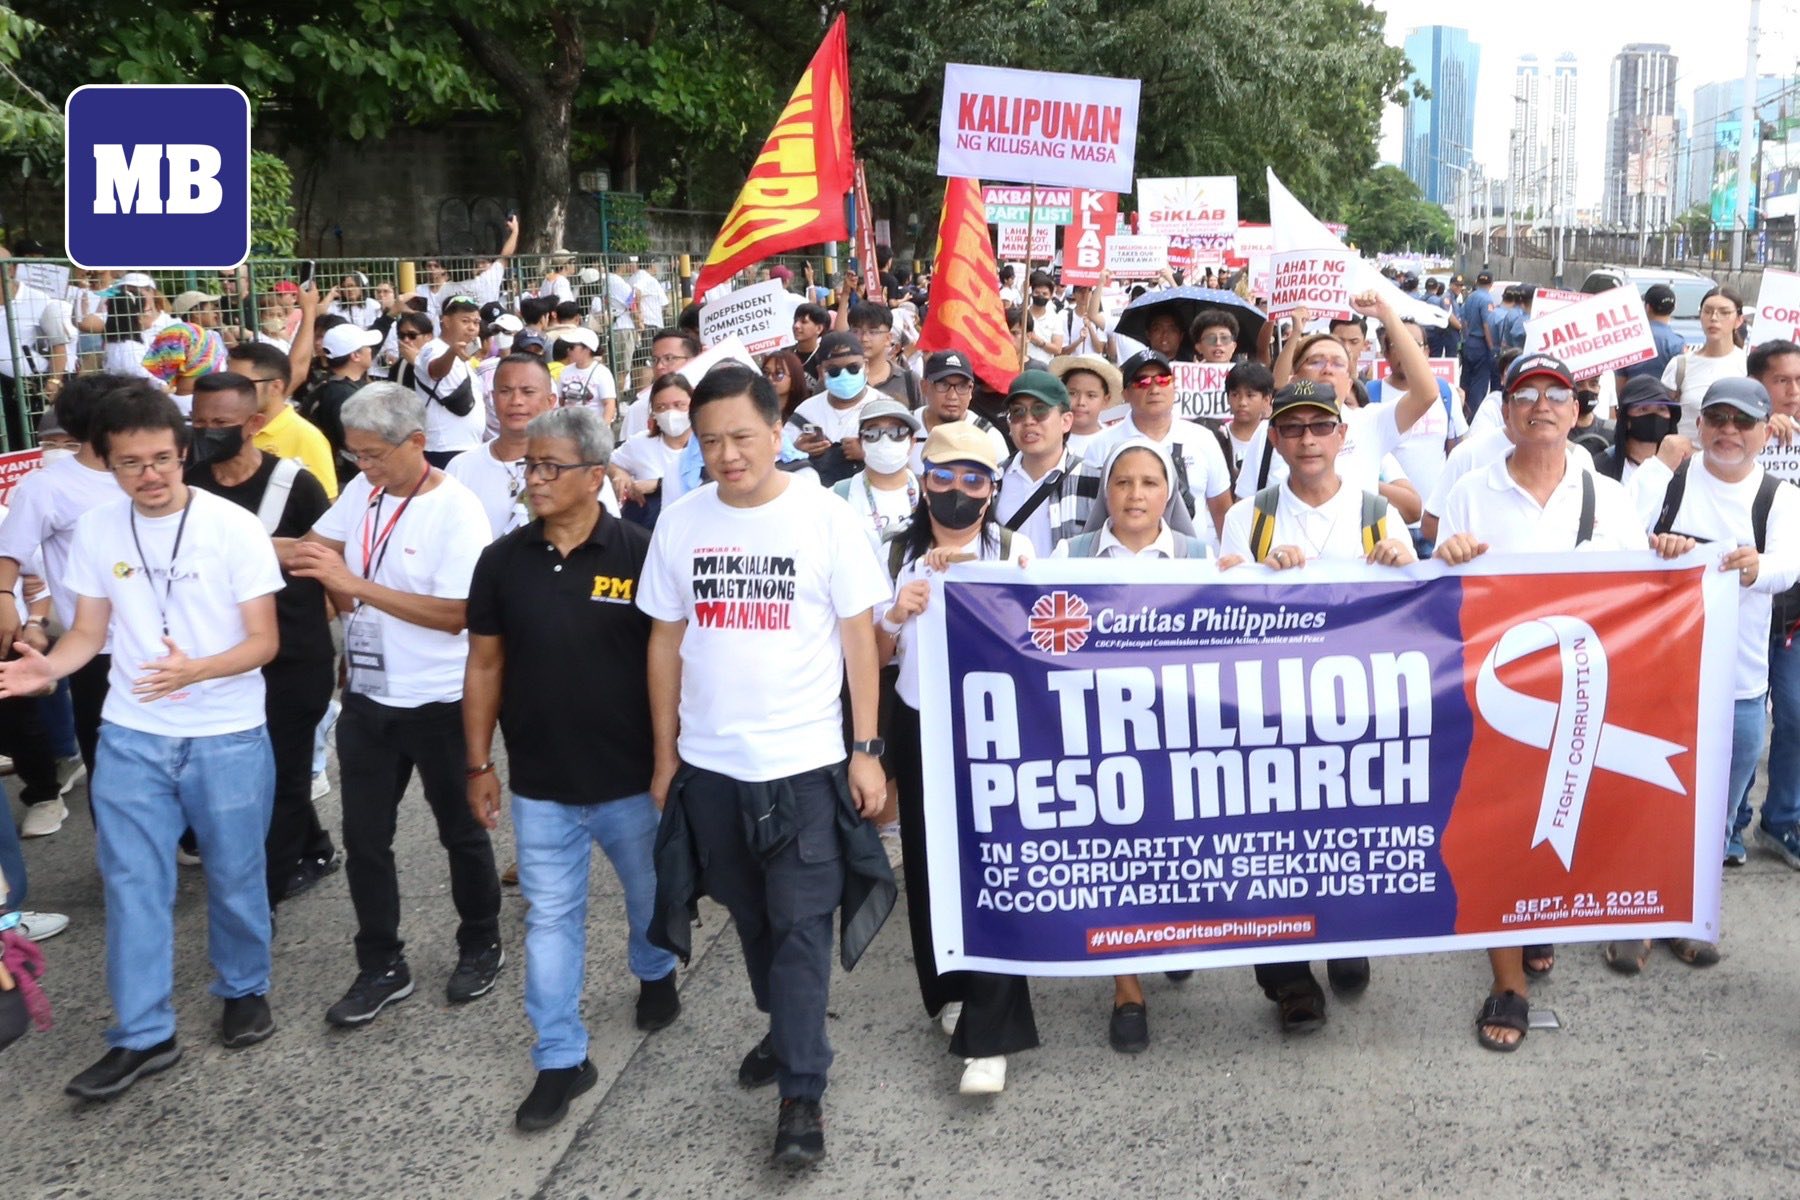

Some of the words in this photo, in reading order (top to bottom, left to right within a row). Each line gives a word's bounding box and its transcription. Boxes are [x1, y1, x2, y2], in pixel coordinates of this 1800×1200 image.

[958, 92, 1122, 145] KALIPUNAN
[957, 133, 981, 151] NG
[987, 136, 1066, 159] KILUSANG
[1070, 145, 1117, 164] MASA
[1149, 209, 1226, 222] SIKLAB
[1275, 273, 1343, 289] KURAKOT,
[1276, 260, 1318, 275] LAHAT
[1323, 260, 1345, 272] NG
[704, 294, 772, 323] INDEPENDENT
[1272, 287, 1347, 306] MANAGOT!
[703, 307, 776, 336] COMMISSION,
[1538, 322, 1587, 351] JAIL
[1596, 304, 1639, 332] ALL
[693, 556, 796, 576] MAKIALAM
[591, 575, 633, 600] PM
[1097, 606, 1186, 634] Caritas
[1190, 605, 1327, 637] Philippines
[1153, 638, 1198, 647] Commission
[1210, 637, 1233, 645] Social
[963, 671, 1021, 760] A
[1047, 650, 1433, 757] TRILLION
[1551, 770, 1578, 828] FIGHT
[1568, 637, 1589, 765] CORRUPTION
[970, 755, 1145, 834] PESO
[1169, 738, 1431, 821] MARCH
[979, 842, 1013, 865] IN
[1020, 835, 1205, 864] SOLIDARITY
[1212, 830, 1295, 856] WITH
[1303, 825, 1436, 850] VICTIMS
[983, 866, 1019, 889] OF
[1027, 857, 1224, 889] CORRUPTION
[1231, 851, 1361, 878] SEEKING
[1368, 849, 1426, 872] FOR
[976, 880, 1239, 913] ACCOUNTABILITY
[1247, 876, 1309, 900] AND
[1316, 872, 1436, 898] JUSTICE
[1515, 895, 1567, 913] SEPT.
[1573, 892, 1599, 909] 21,
[1606, 890, 1658, 906] 2025
[1502, 913, 1531, 924] EDSA
[1534, 909, 1569, 921] People
[1571, 906, 1604, 918] Power
[1607, 904, 1664, 916] Monument
[1090, 920, 1312, 947] #WeAreCaritasPhilippines
